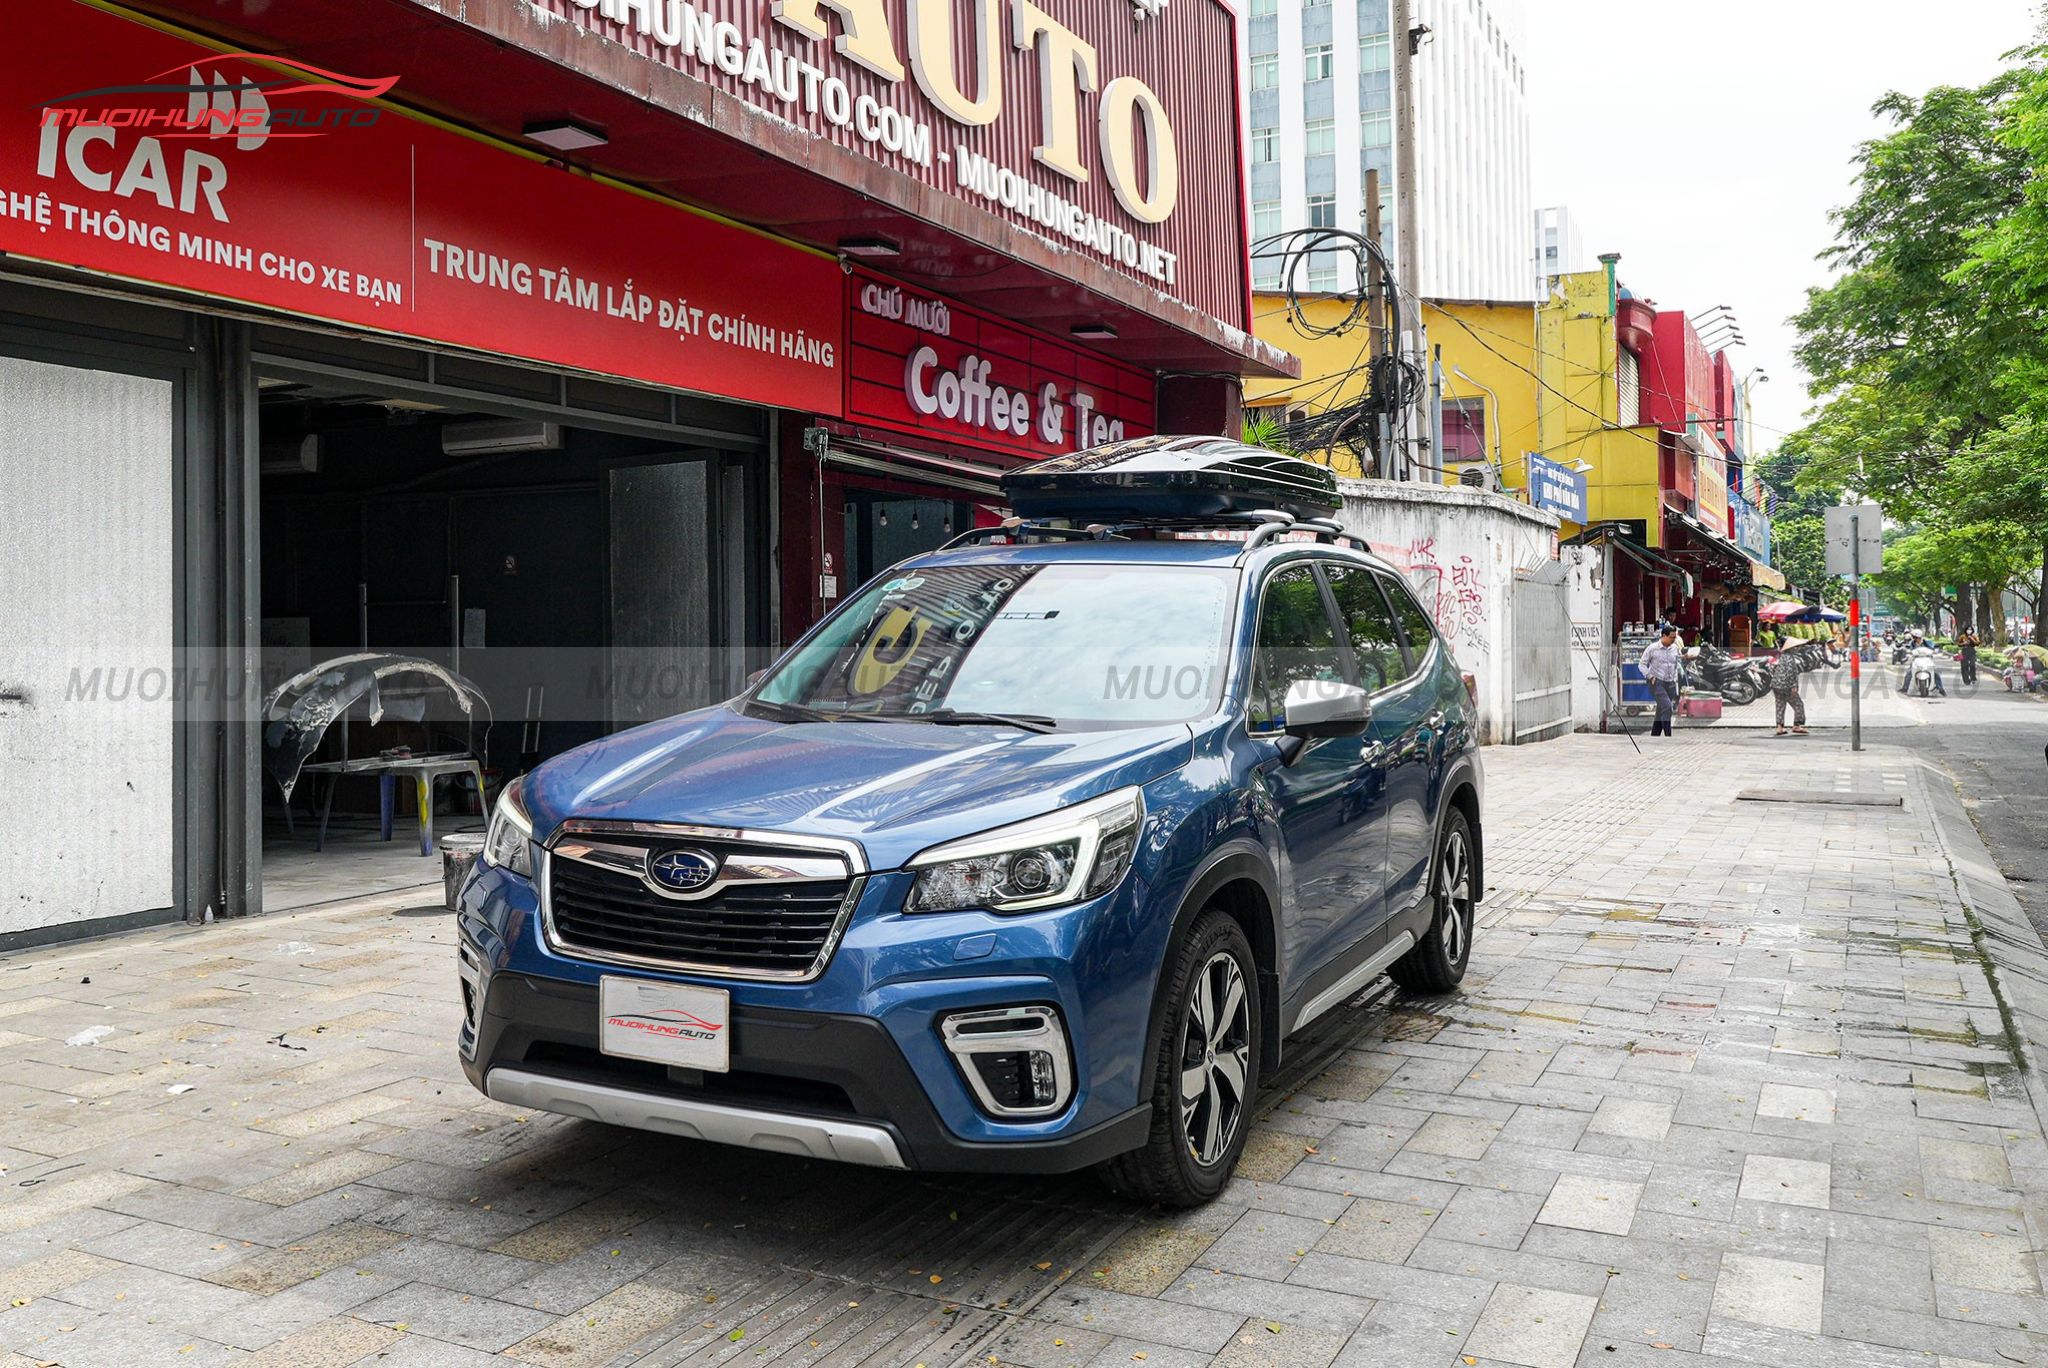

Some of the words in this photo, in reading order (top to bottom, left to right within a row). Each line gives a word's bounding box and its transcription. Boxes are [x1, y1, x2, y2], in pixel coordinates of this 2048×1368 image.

[59, 202, 171, 253] THÔNG
[178, 232, 252, 272] MINH
[259, 252, 316, 285] CHO
[321, 265, 350, 294] XE
[356, 274, 401, 307] BẠN
[957, 145, 1177, 285] MUOIHUNGAUTO.NET
[423, 237, 533, 297] TRUNG
[538, 266, 599, 312] TÂM
[606, 278, 653, 323] LẮP
[658, 298, 703, 341] ĐẶT
[707, 313, 775, 354] CHÍNH
[780, 329, 834, 368] HÃNG
[861, 283, 902, 321] CHÚ
[904, 346, 1030, 437] Coffee
[1037, 382, 1064, 445] &
[608, 1017, 717, 1040] MUOIHUNGAUTO
